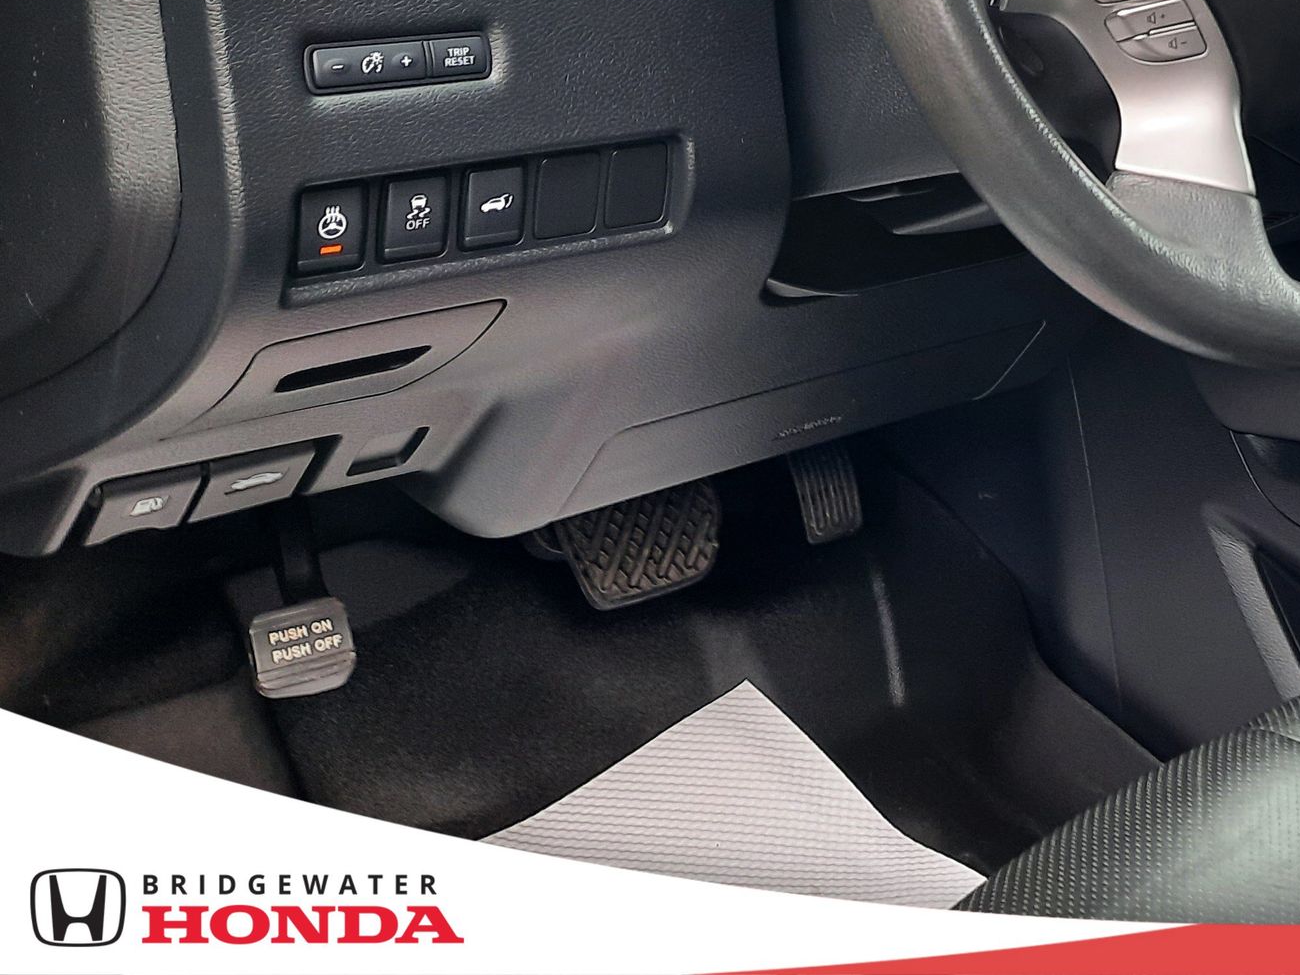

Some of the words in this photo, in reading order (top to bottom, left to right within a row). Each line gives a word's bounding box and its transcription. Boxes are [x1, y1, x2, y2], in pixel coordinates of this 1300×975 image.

[448, 46, 470, 57] TRIP
[444, 55, 476, 67] RESET
[405, 217, 431, 231] OFF
[268, 625, 308, 645] PUSH
[310, 618, 334, 635] ON
[272, 642, 312, 664] PUSH
[314, 634, 343, 653] OFF
